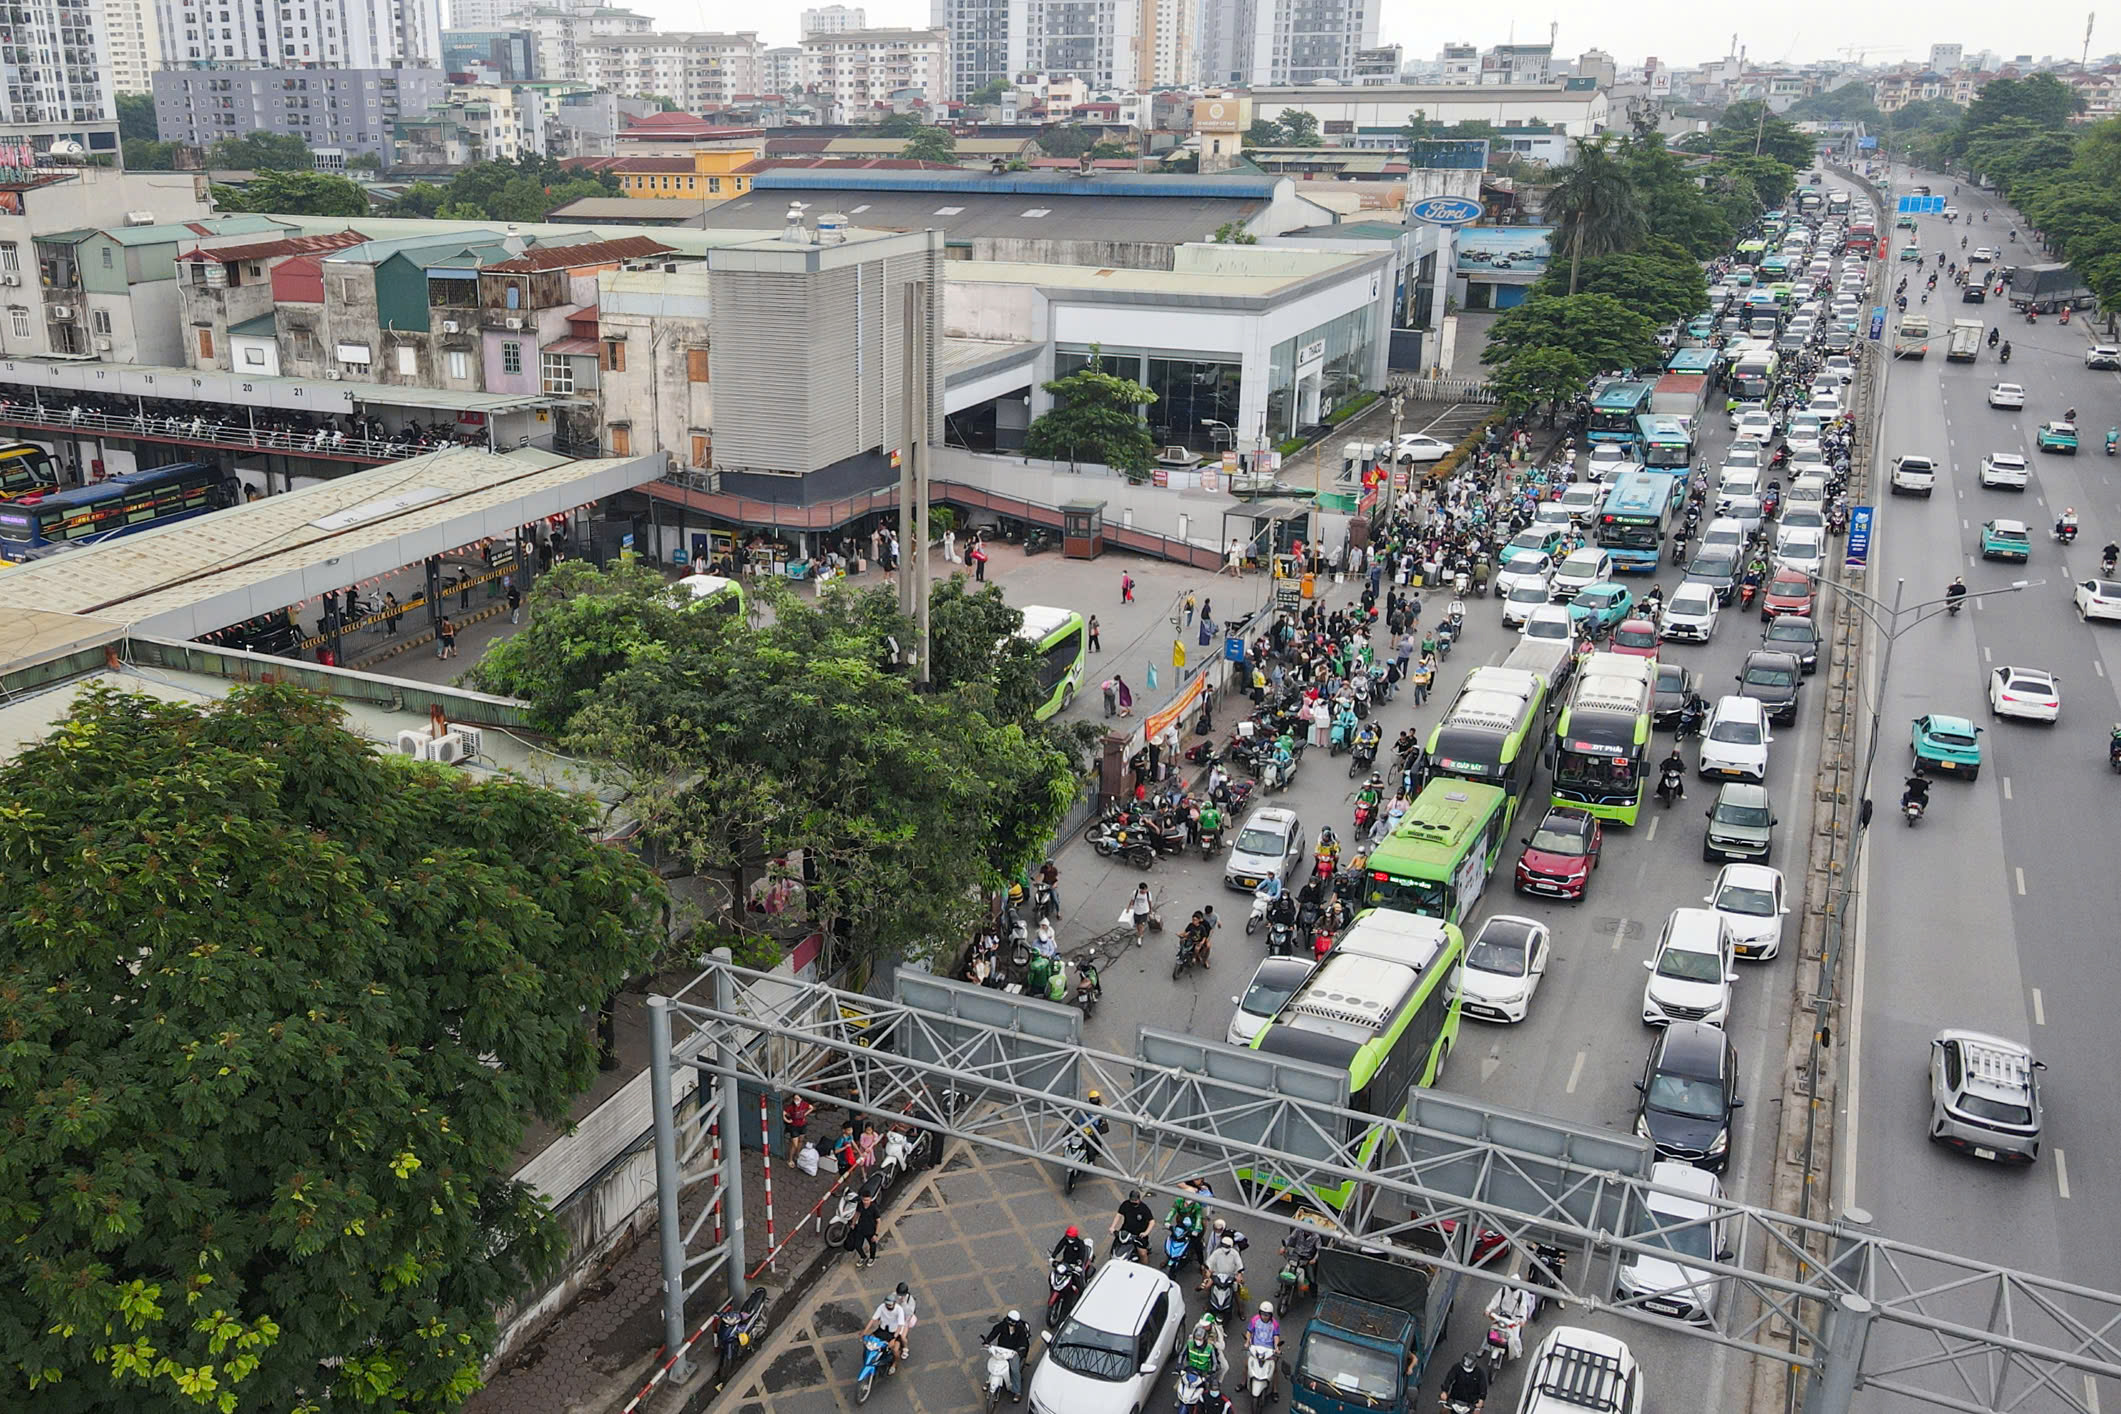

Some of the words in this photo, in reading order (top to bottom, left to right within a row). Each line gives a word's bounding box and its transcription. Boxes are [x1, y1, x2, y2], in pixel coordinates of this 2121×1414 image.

[1424, 200, 1468, 220] Ford
[5, 362, 14, 371] 15
[50, 367, 59, 375] 16
[96, 371, 105, 379] 17
[144, 375, 153, 384] 18
[192, 379, 202, 387] 19
[242, 383, 253, 392] 20
[294, 387, 303, 396] 21
[343, 390, 353, 400] 22
